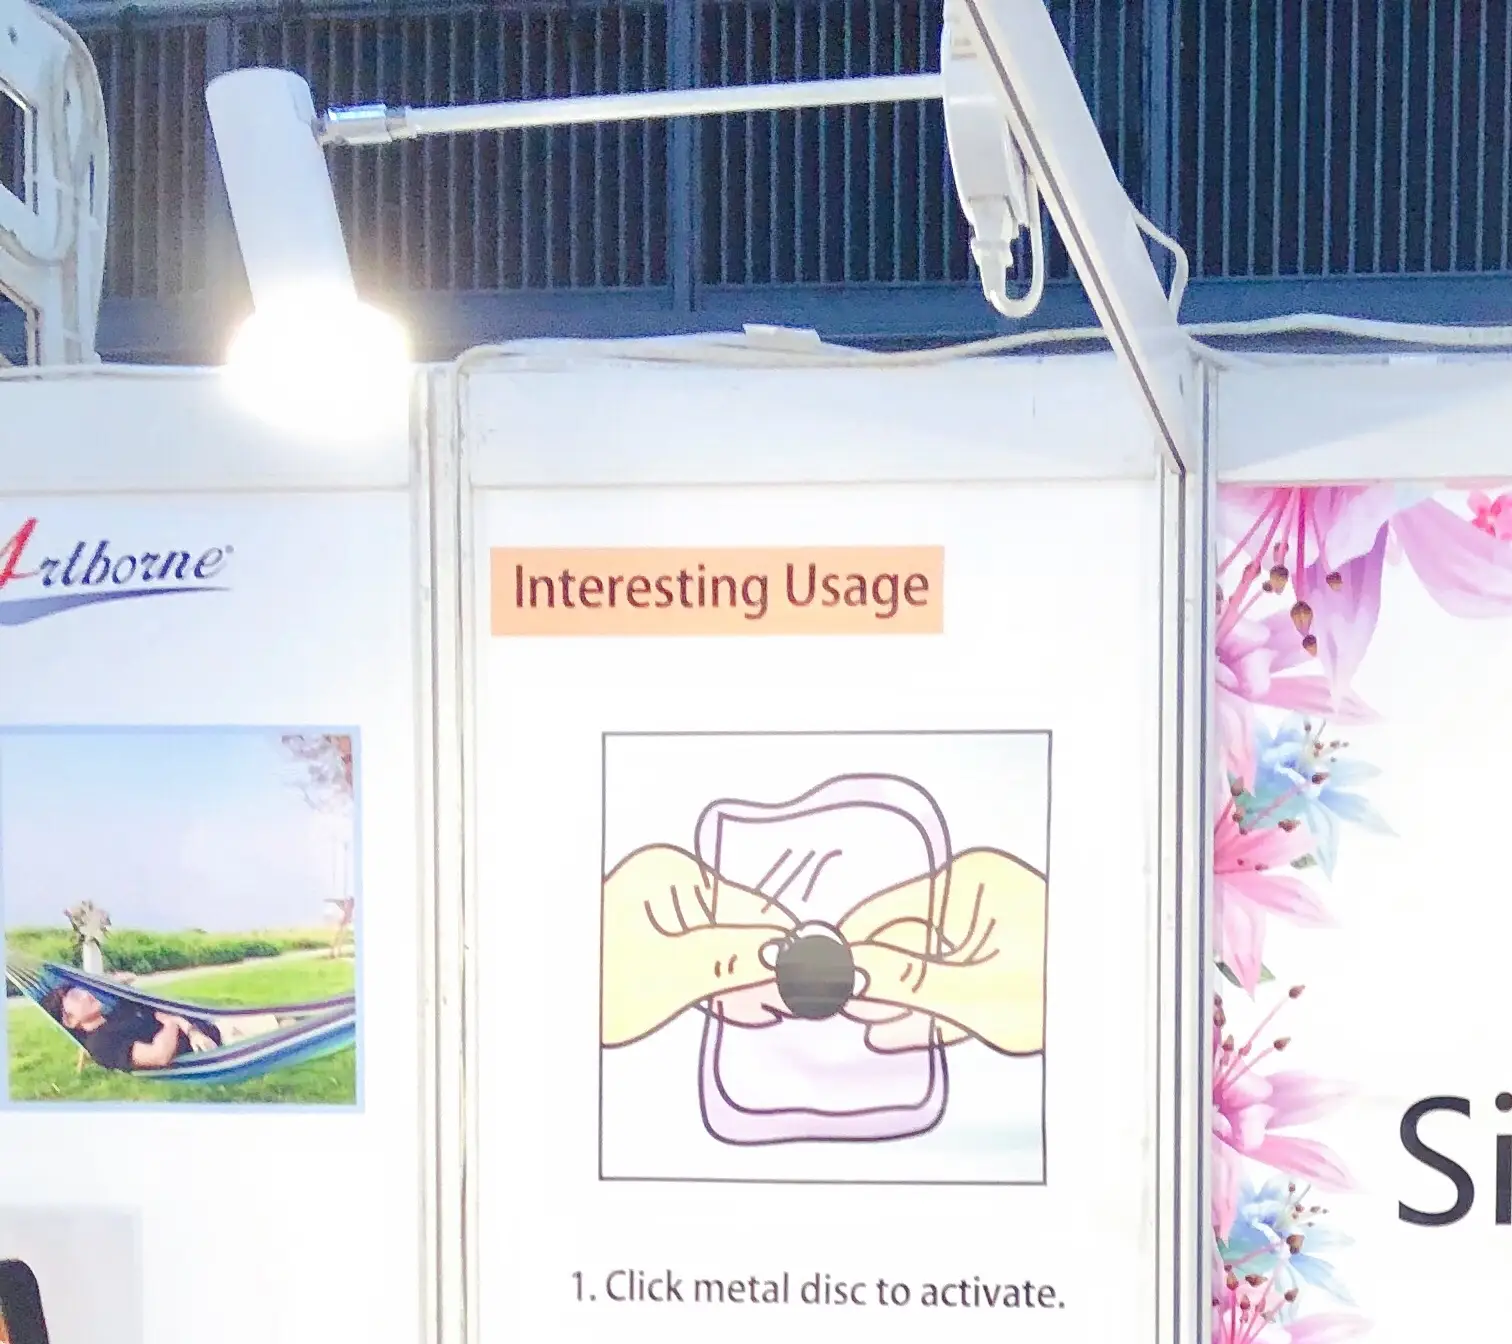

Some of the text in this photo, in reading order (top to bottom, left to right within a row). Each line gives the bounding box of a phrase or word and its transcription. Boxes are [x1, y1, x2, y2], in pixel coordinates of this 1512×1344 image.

[515, 563, 929, 620] Interesting Usage
[571, 1269, 1066, 1310] 1. Click metal disc to activate.
